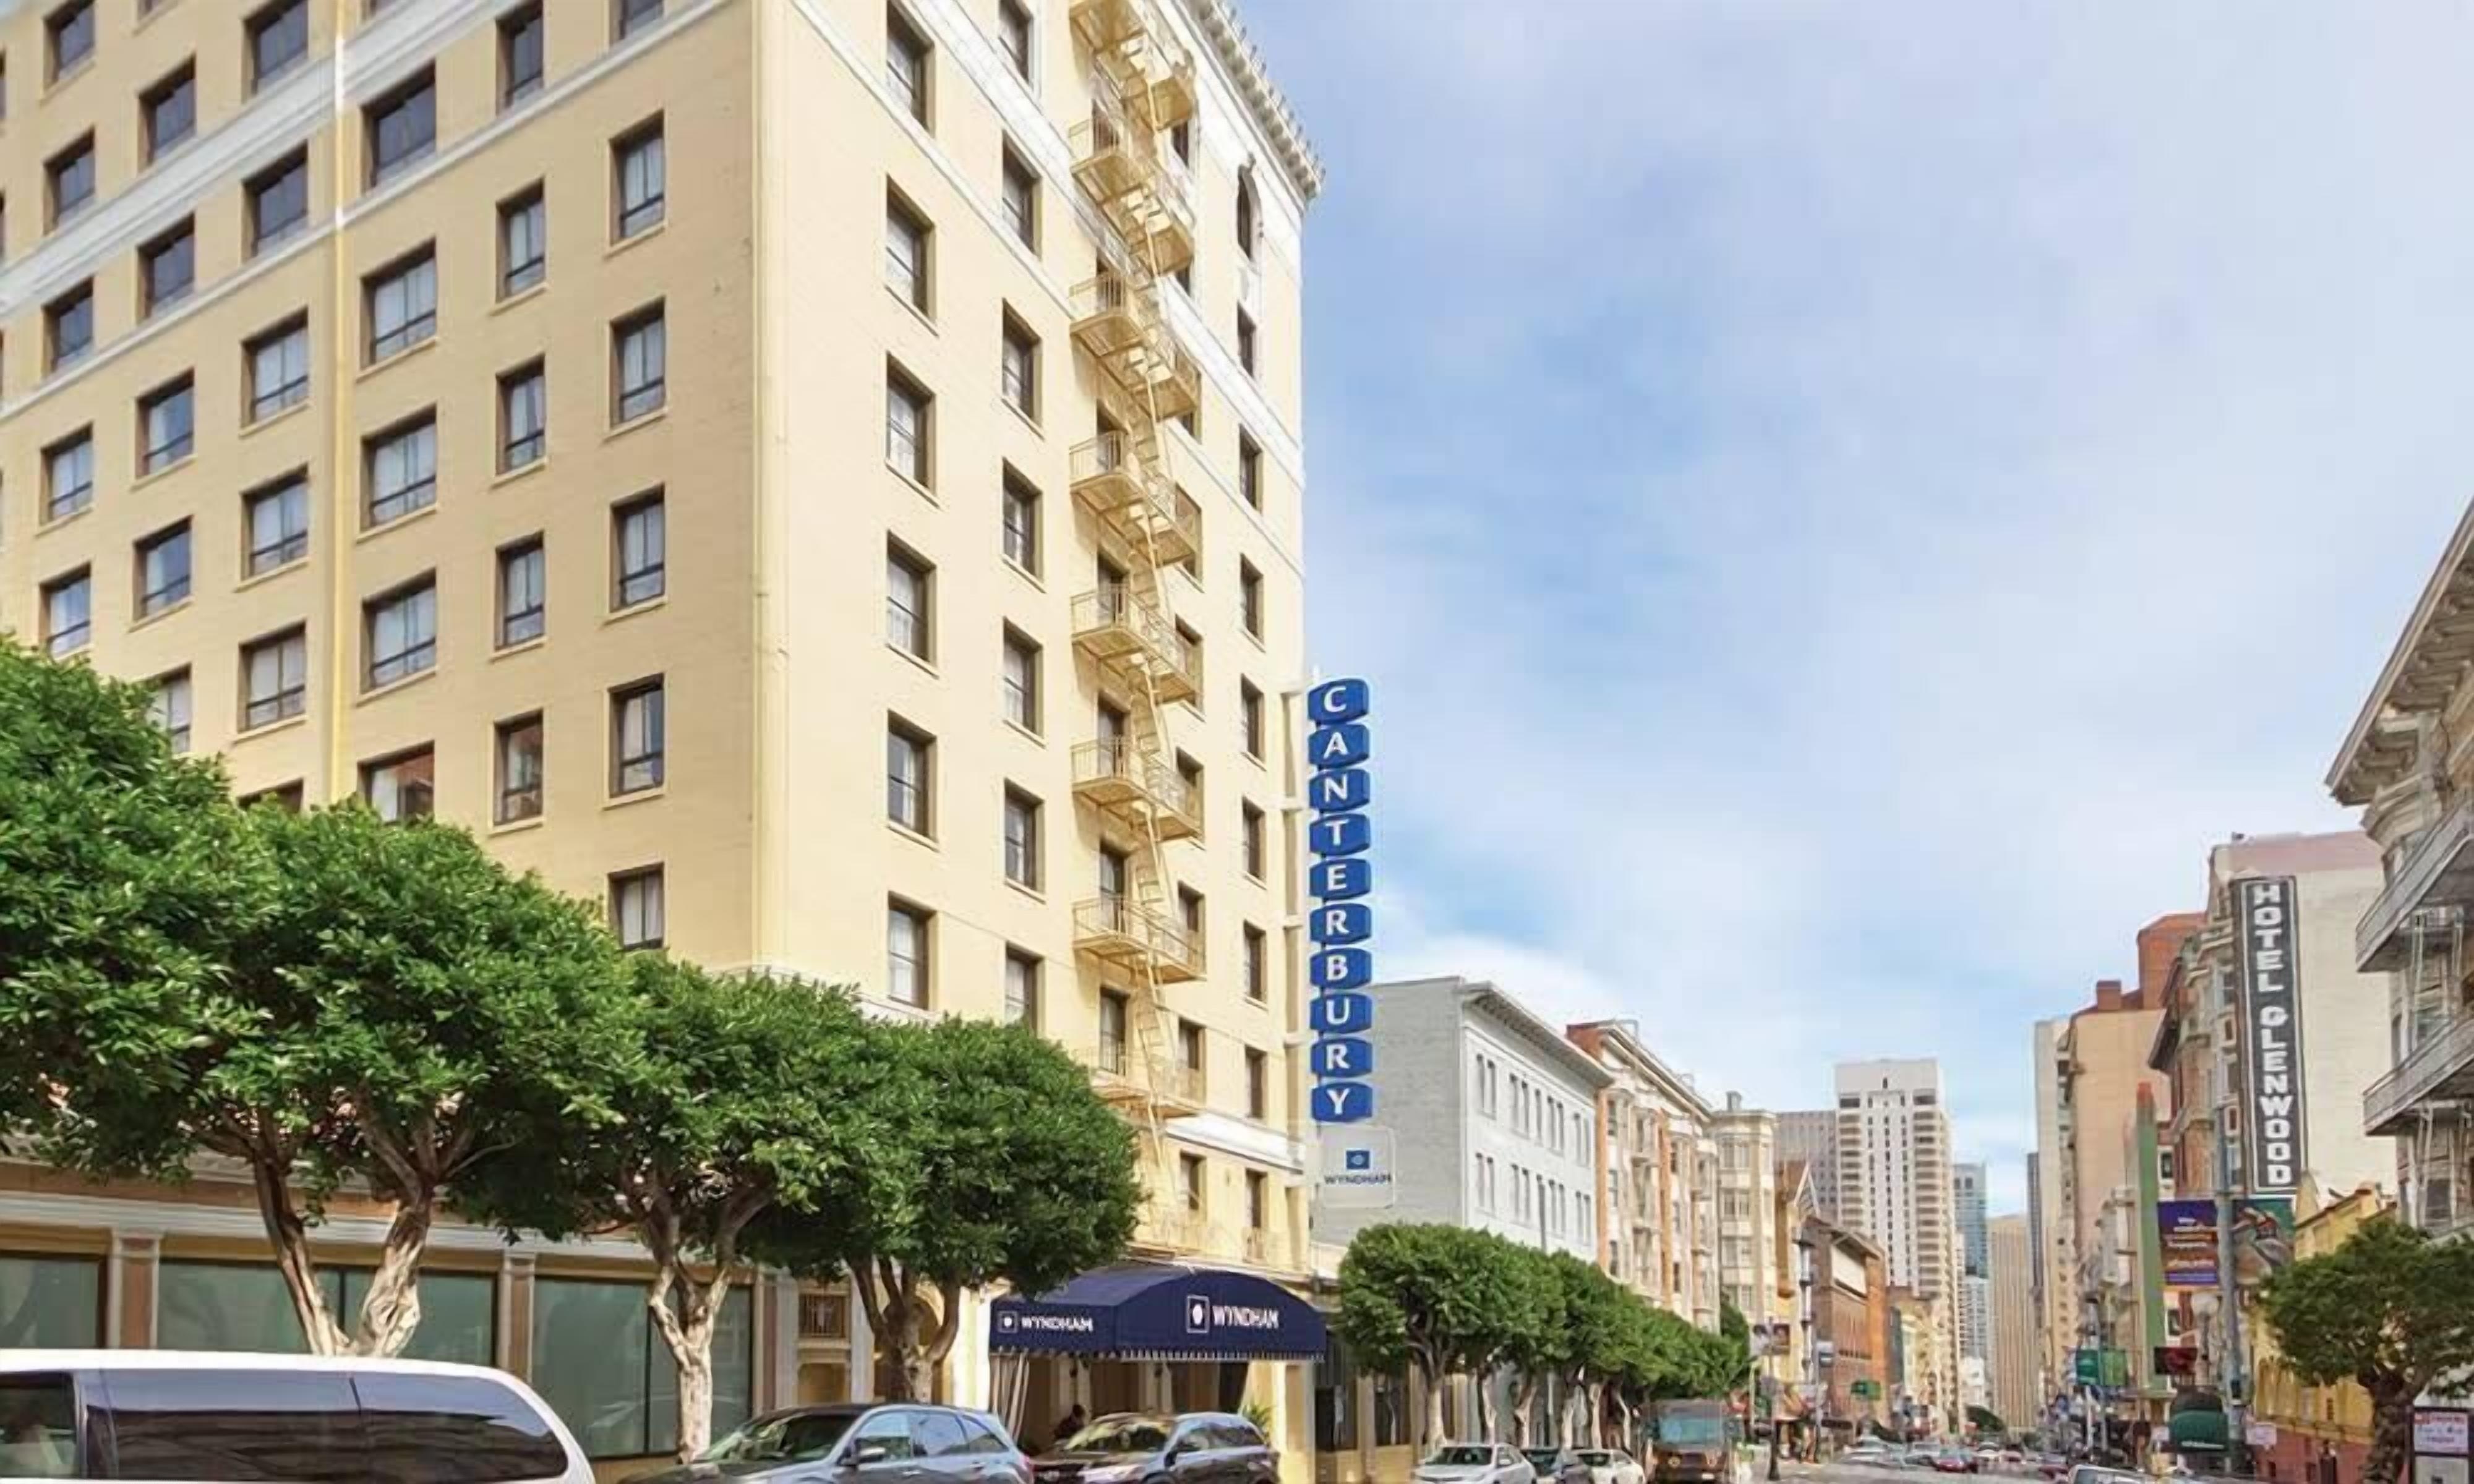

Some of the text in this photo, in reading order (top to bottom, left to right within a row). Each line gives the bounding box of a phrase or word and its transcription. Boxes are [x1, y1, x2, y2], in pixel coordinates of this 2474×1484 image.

[1323, 686, 1351, 1115] CANTERBURY
[2253, 884, 2293, 1185] HOTEL GLENWOOD
[1324, 1173, 1392, 1185] WYNDHAM
[1022, 1315, 1094, 1332] WYNDHAM
[1212, 1305, 1280, 1329] WYNDHAM
